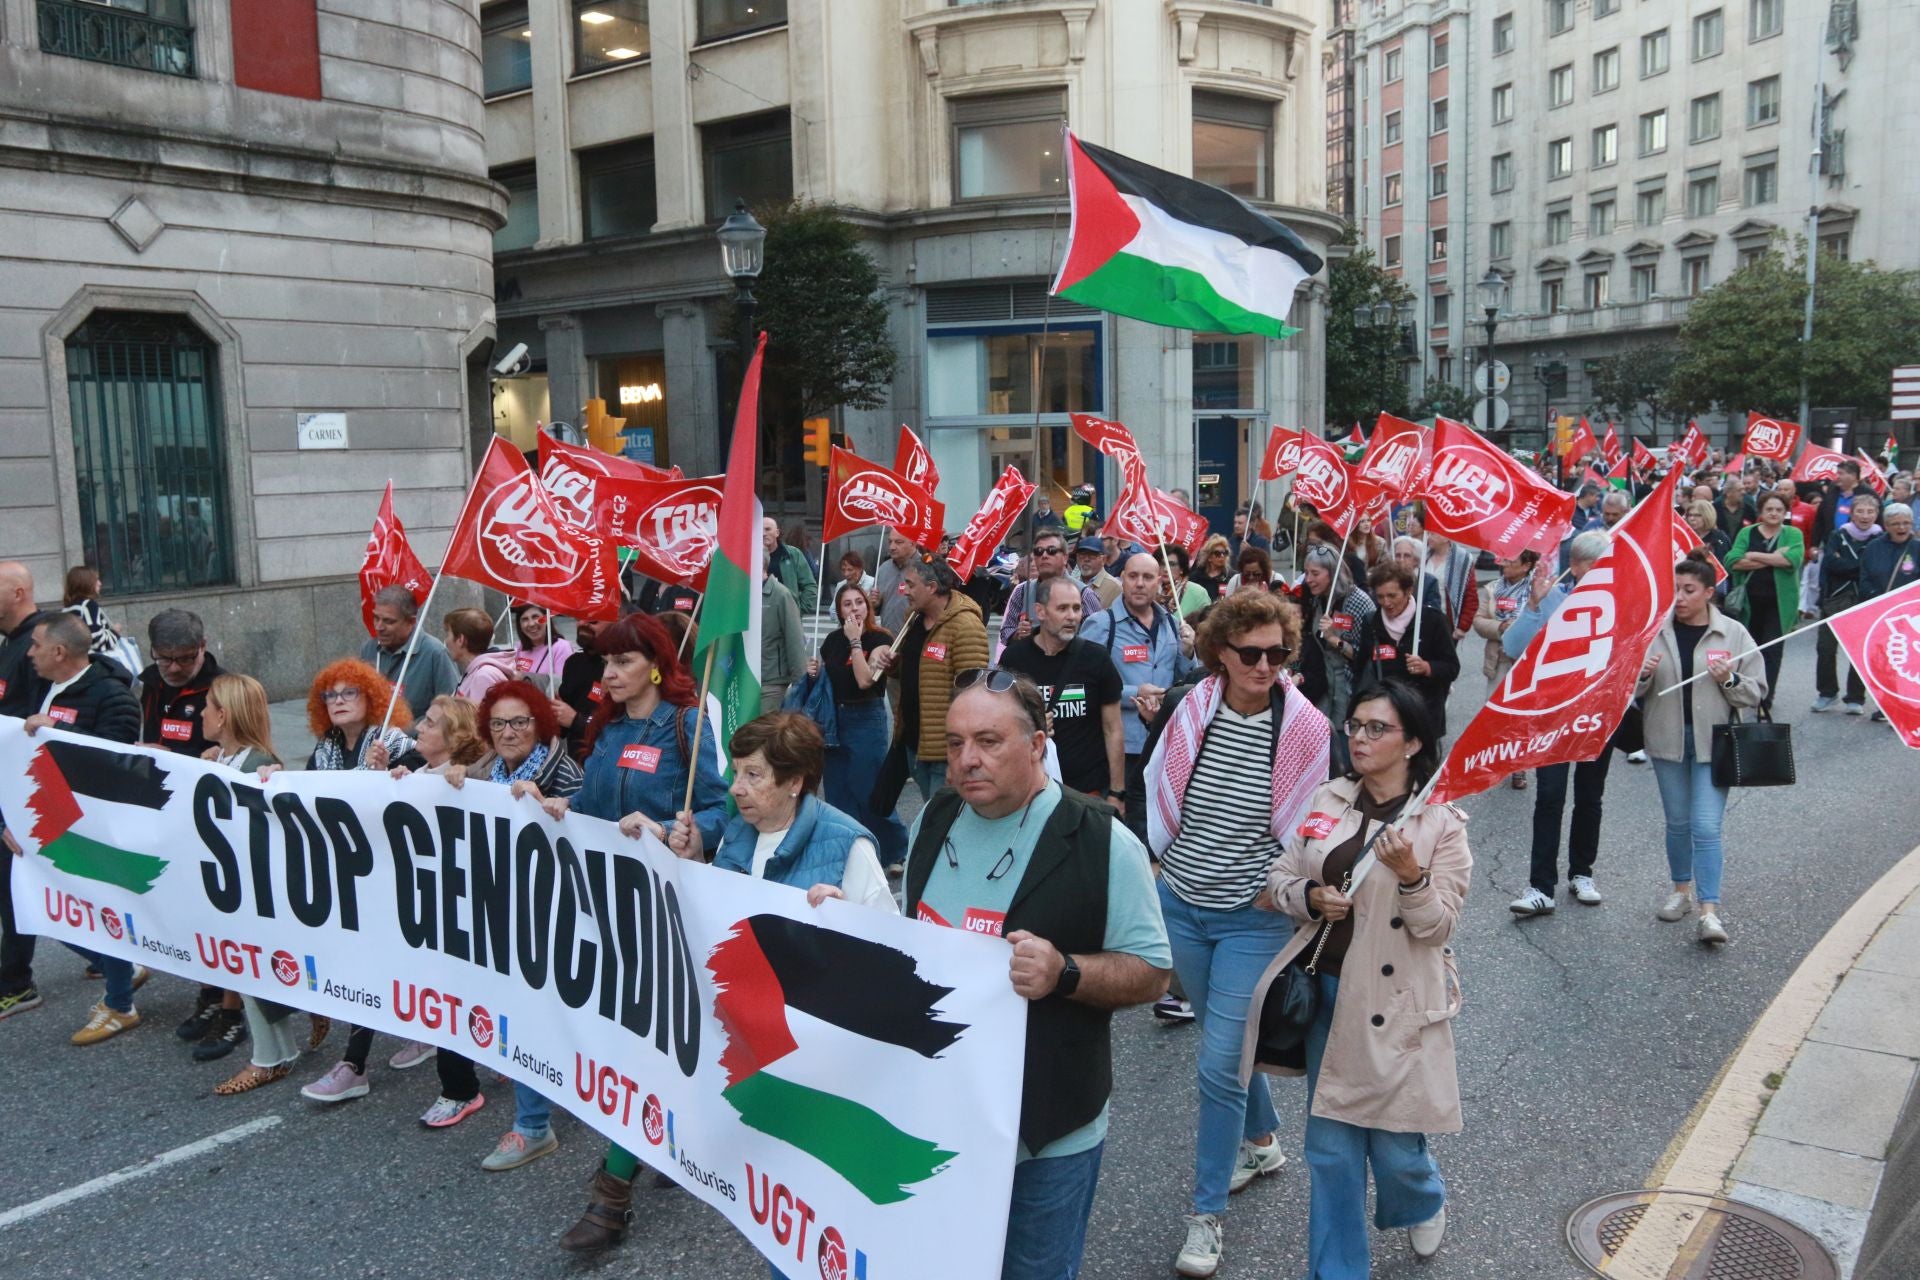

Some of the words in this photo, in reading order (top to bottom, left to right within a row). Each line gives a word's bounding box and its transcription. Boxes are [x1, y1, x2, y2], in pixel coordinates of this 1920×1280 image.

[619, 383, 662, 405] BBVA
[309, 429, 342, 440] CARMEN
[1752, 424, 1779, 444] UGT
[542, 456, 596, 511] UGT
[1297, 450, 1343, 491] UGT
[1433, 453, 1506, 502] UGT
[849, 480, 910, 516] UGT
[1498, 489, 1548, 544] www.ugt.es
[50, 710, 65, 720] UGT
[163, 724, 179, 732] UGT
[623, 750, 642, 760] UGT
[1463, 711, 1603, 773] www.ugt.es
[1305, 817, 1323, 828] UGT
[45, 886, 95, 932] UGT
[142, 935, 192, 962] Asturias
[193, 773, 374, 932] STOP
[382, 801, 702, 1077] GENOCIDIO
[966, 916, 994, 933] UGT
[195, 933, 263, 979] UGT
[323, 978, 382, 1009] Asturias
[393, 979, 463, 1036] UGT
[512, 1045, 564, 1087] Asturias
[575, 1051, 639, 1127] UGT
[680, 1149, 737, 1202] Asturias
[745, 1162, 816, 1263] UGT
